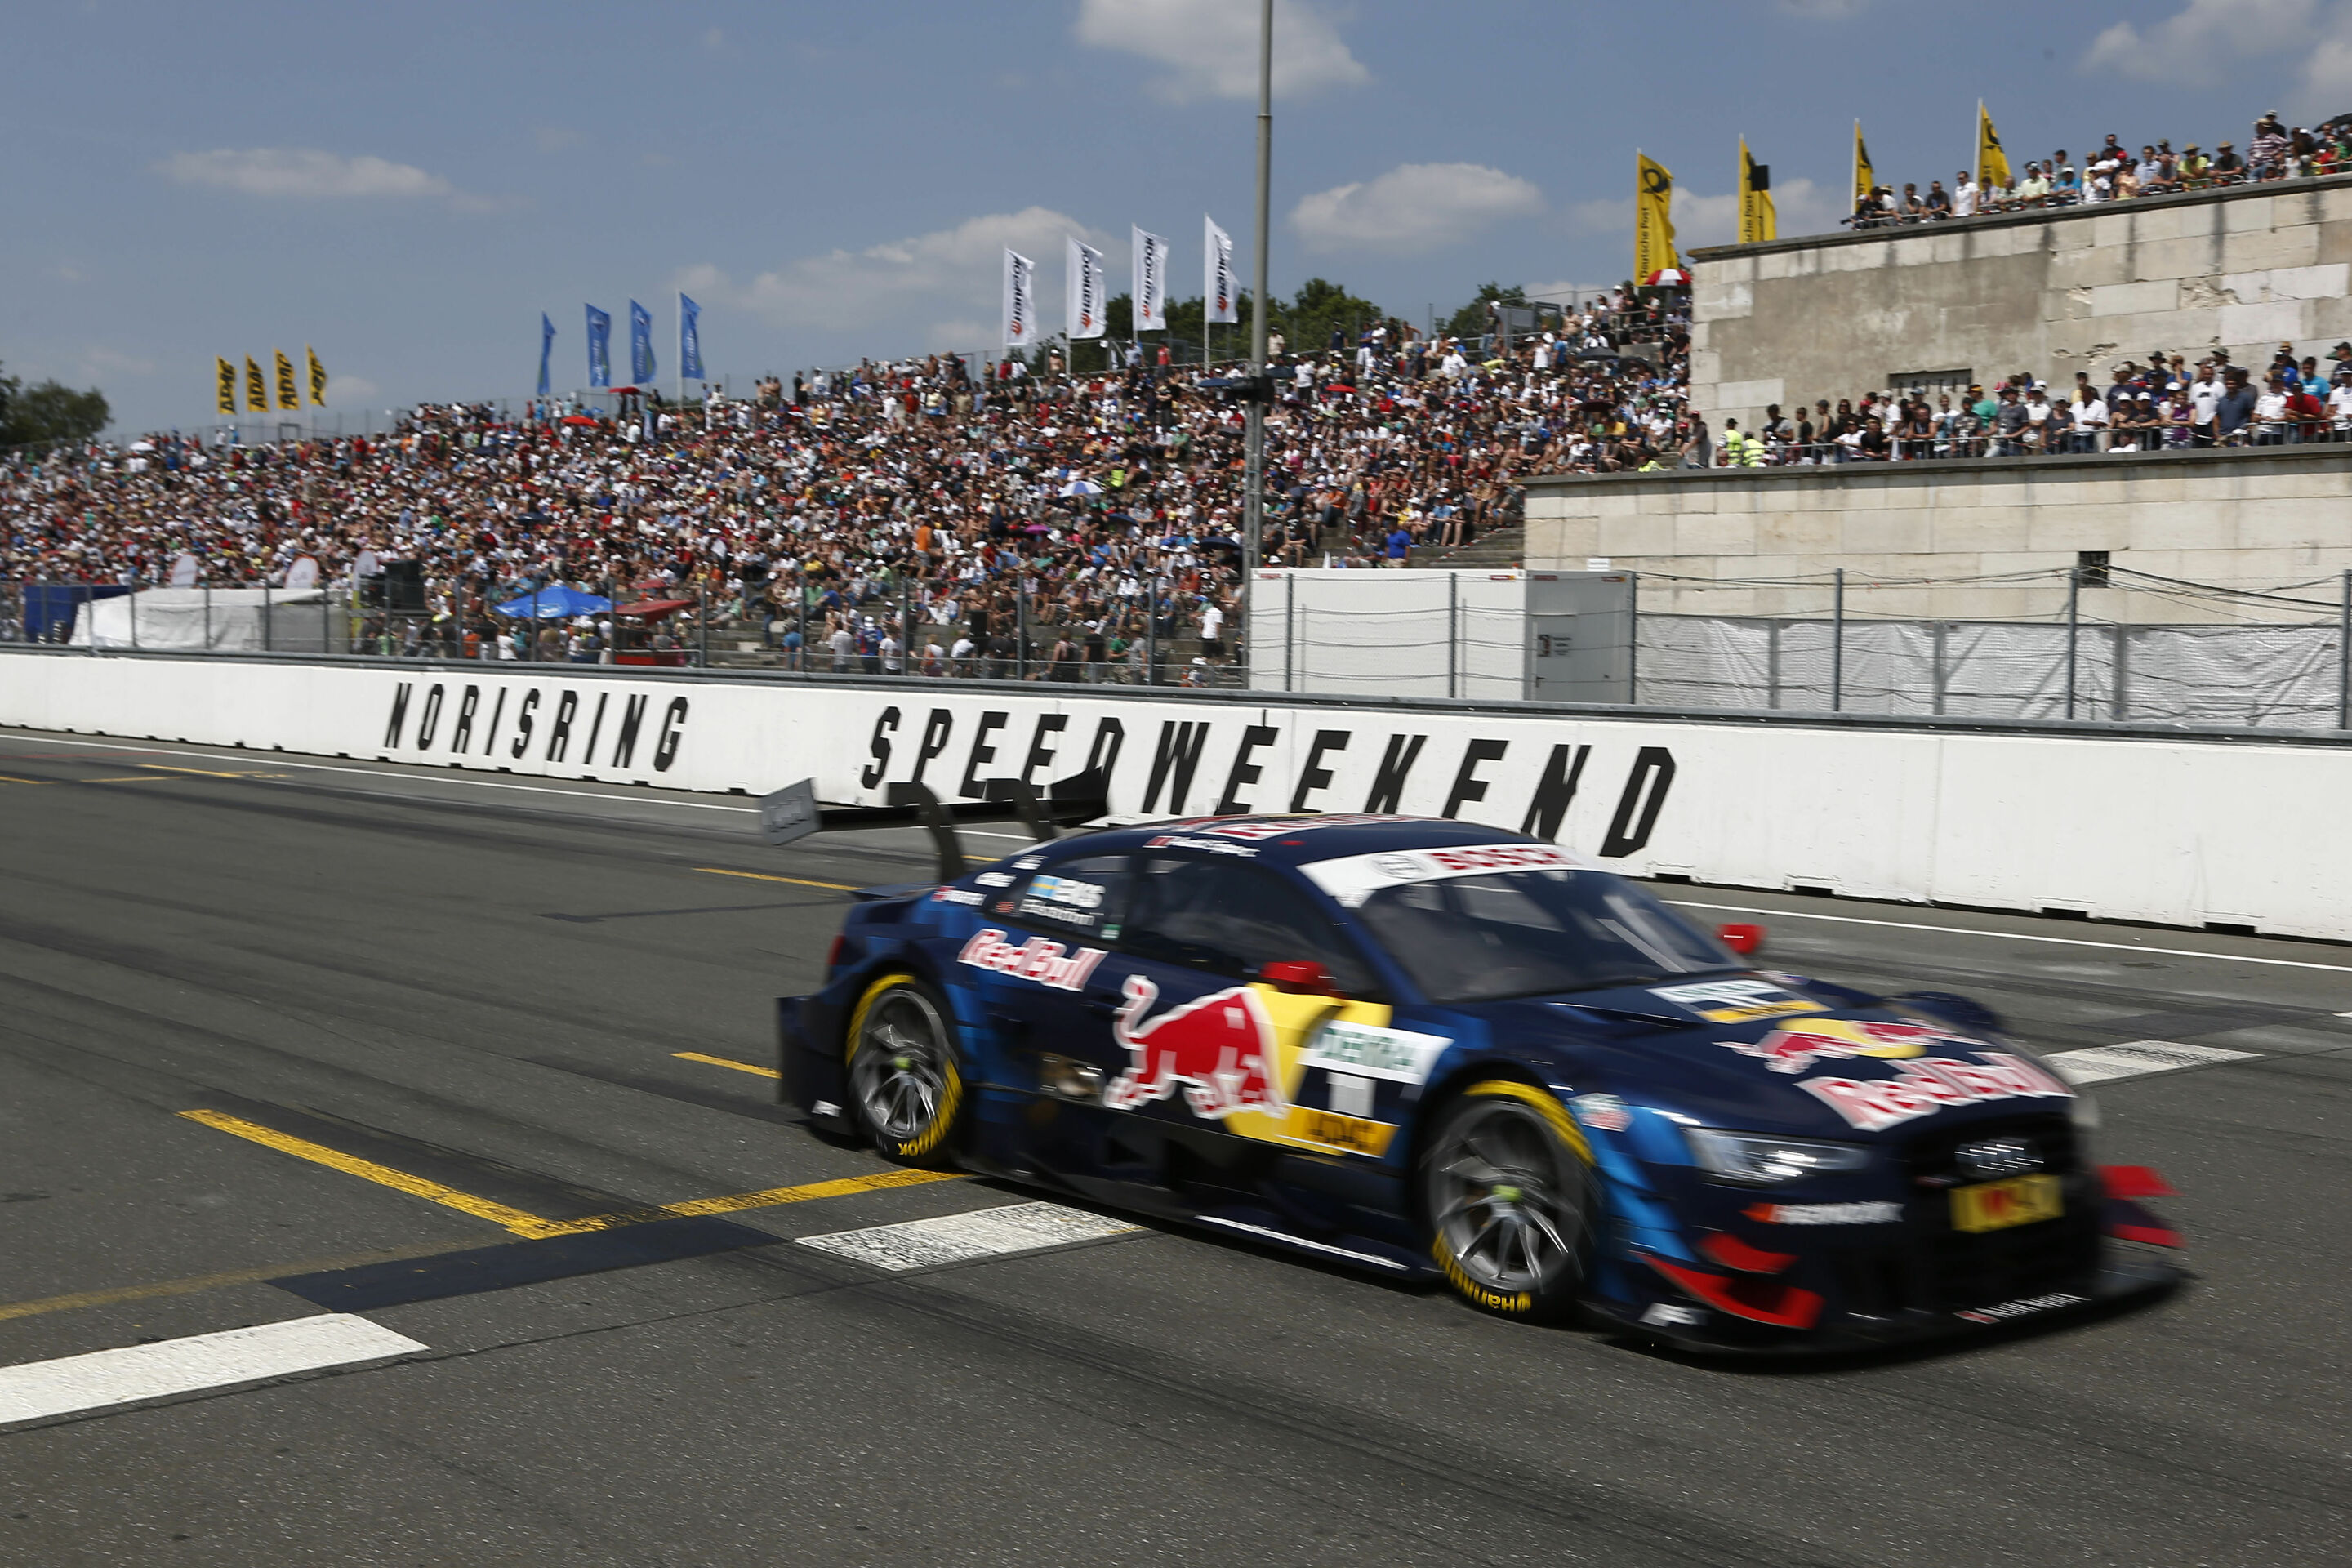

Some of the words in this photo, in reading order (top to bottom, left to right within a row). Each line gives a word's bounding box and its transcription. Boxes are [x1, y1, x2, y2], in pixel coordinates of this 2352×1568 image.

[1639, 207, 1650, 229] Post
[1744, 195, 1754, 217] Post
[1639, 231, 1650, 278] Deutsche
[384, 681, 689, 773] NORISRING
[1428, 848, 1583, 871] BOSCH
[956, 928, 1039, 977] Red
[1021, 936, 1109, 992] Bull
[1793, 1060, 1983, 1132] Red
[1907, 1051, 2078, 1104] Bull
